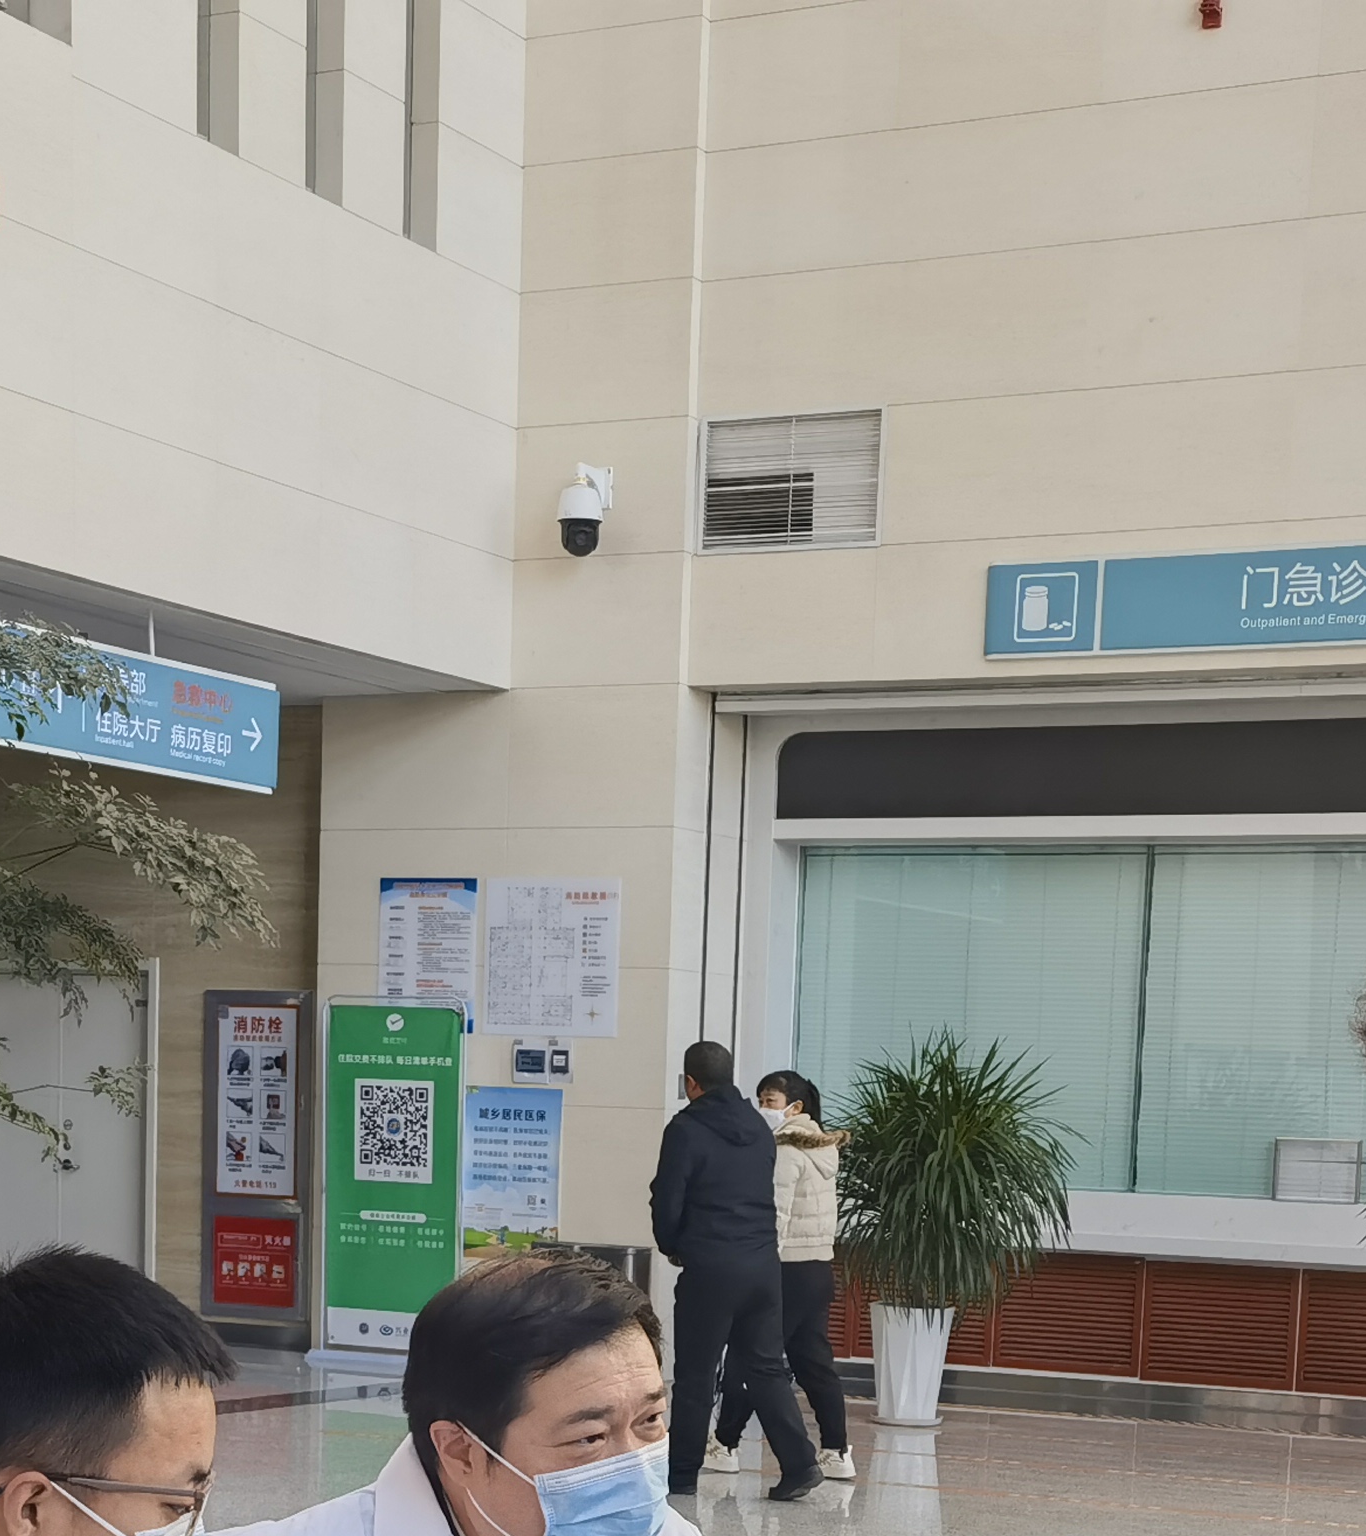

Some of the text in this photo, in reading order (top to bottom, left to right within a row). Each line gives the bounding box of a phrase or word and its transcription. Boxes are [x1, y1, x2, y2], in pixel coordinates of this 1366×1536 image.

[1240, 615, 1301, 630] Outpatient
[1303, 614, 1325, 626] and
[95, 707, 162, 744] 住院大厅
[170, 723, 233, 758] 病历复印
[233, 1015, 283, 1035] 消防栓
[478, 1107, 547, 1122] 城乡居民医保
